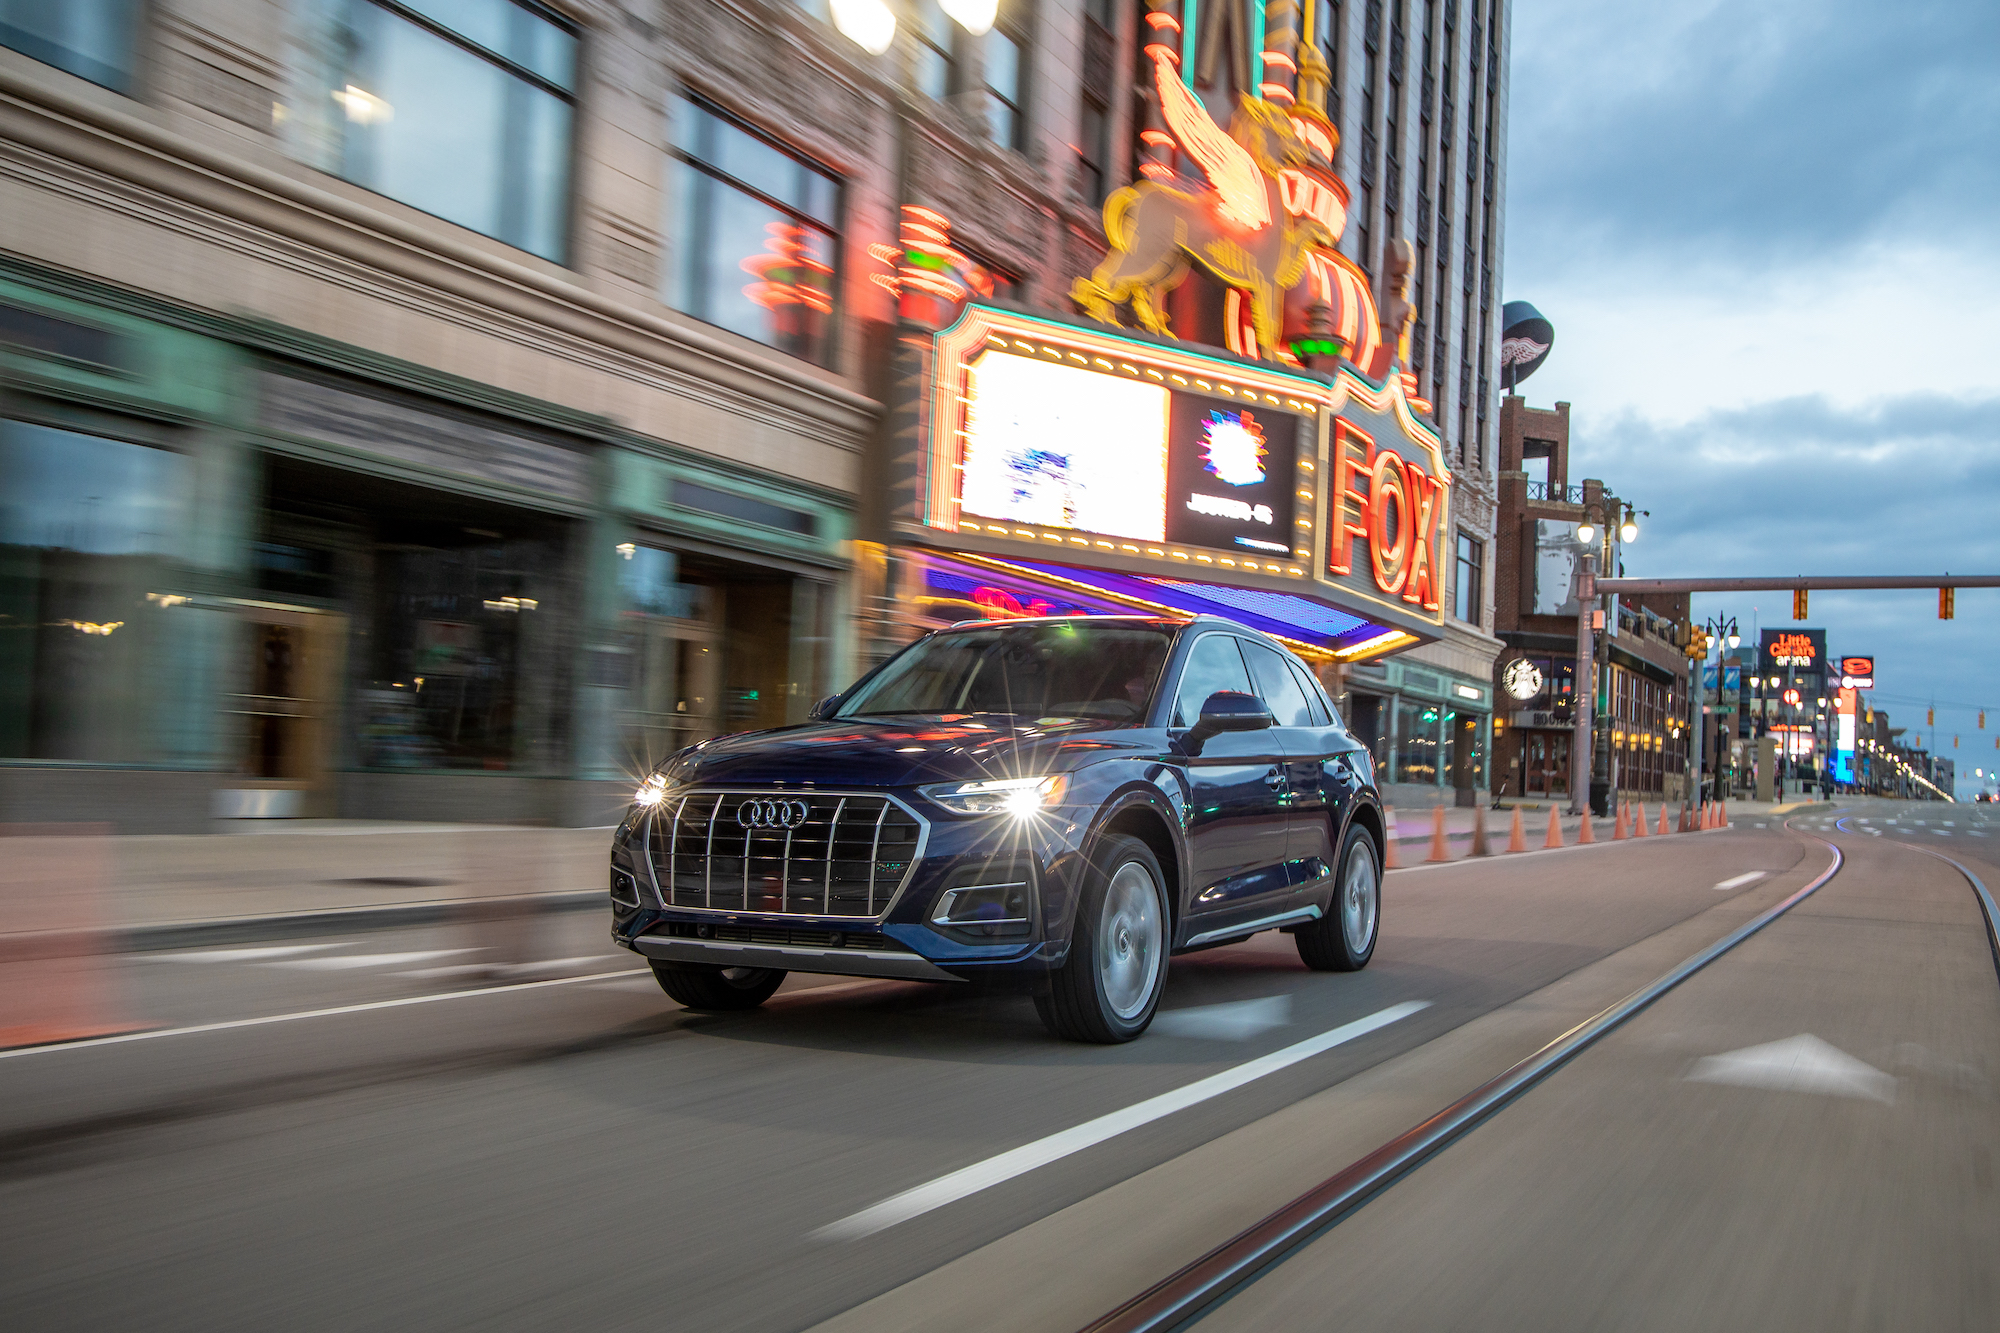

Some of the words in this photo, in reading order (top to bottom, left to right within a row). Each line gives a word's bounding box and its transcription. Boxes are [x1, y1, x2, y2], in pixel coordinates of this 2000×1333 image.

[1330, 415, 1443, 611] FOX
[1779, 633, 1811, 647] Little
[1776, 655, 1812, 667] arena
